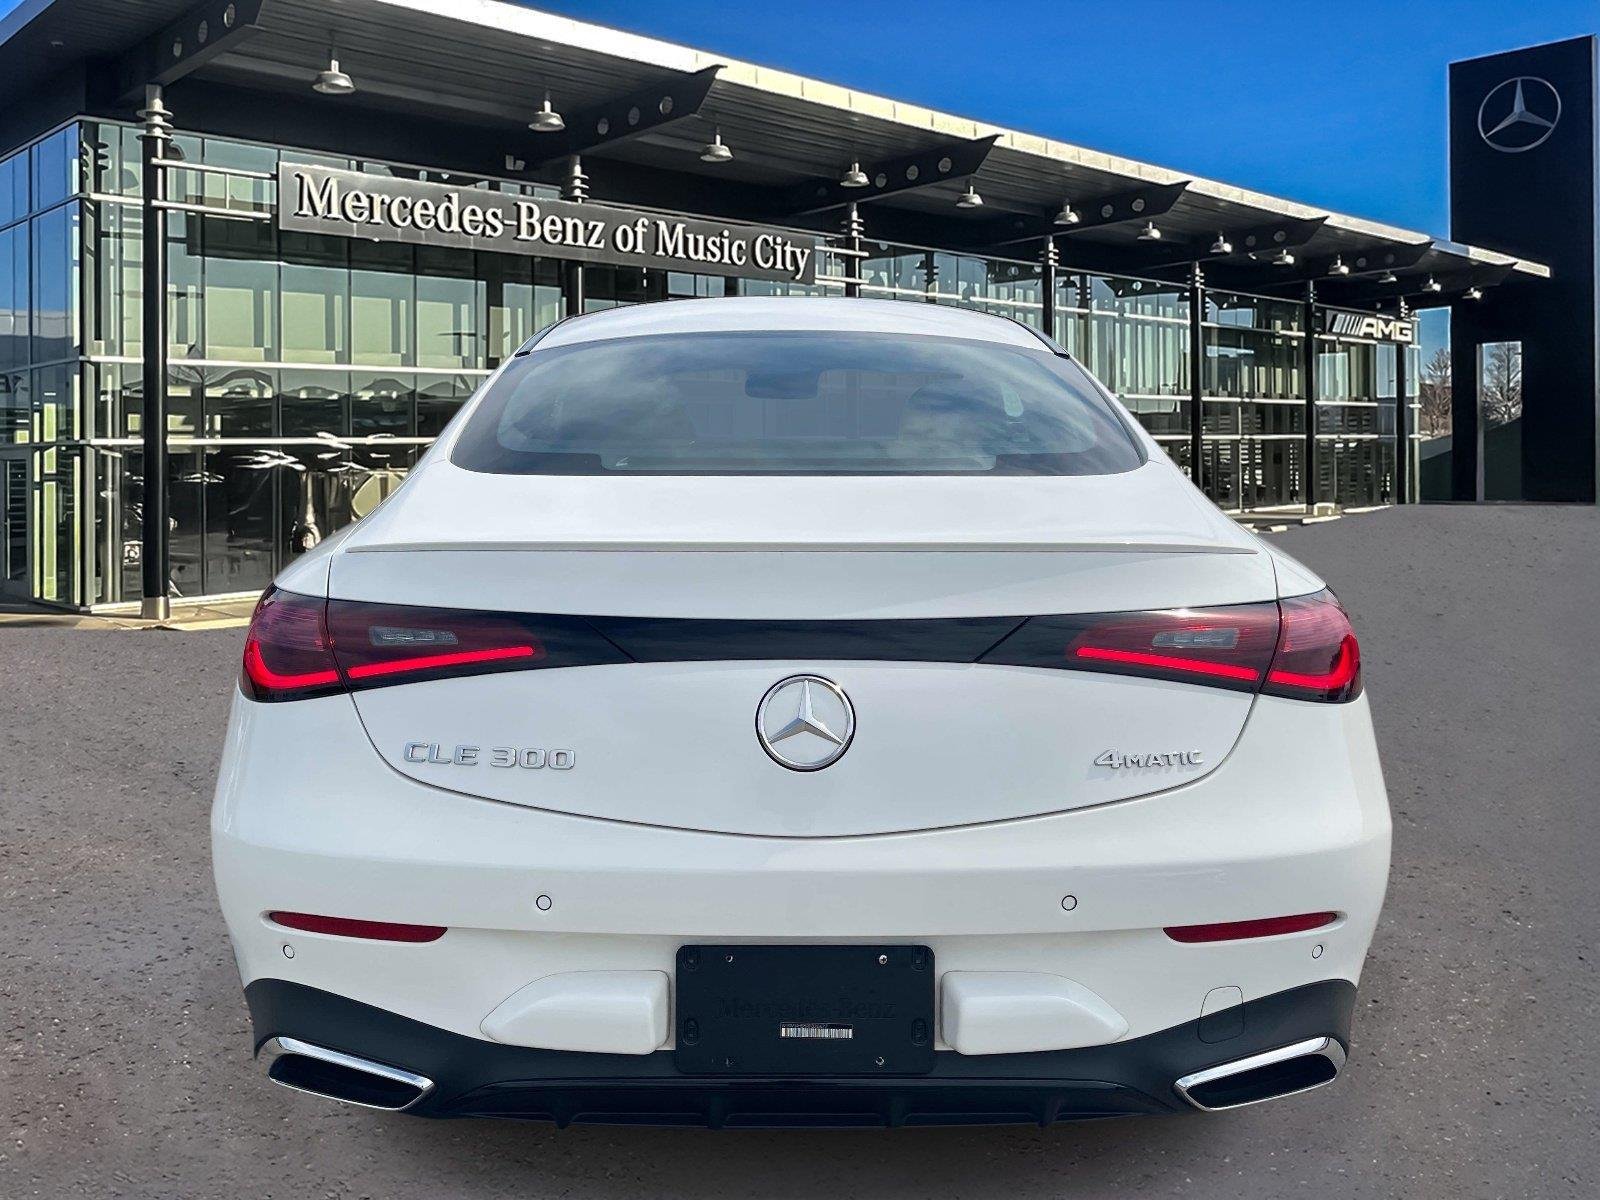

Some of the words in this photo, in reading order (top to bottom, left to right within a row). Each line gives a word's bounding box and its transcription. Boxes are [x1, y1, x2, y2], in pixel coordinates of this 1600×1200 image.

[296, 171, 605, 249] Mercedes-Benz
[614, 217, 649, 254] of
[656, 219, 748, 266] Music
[754, 234, 811, 280] City
[1358, 316, 1413, 342] AMG
[403, 741, 480, 766] CLE
[490, 747, 576, 770] 300
[1093, 748, 1204, 769] 4MATIC
